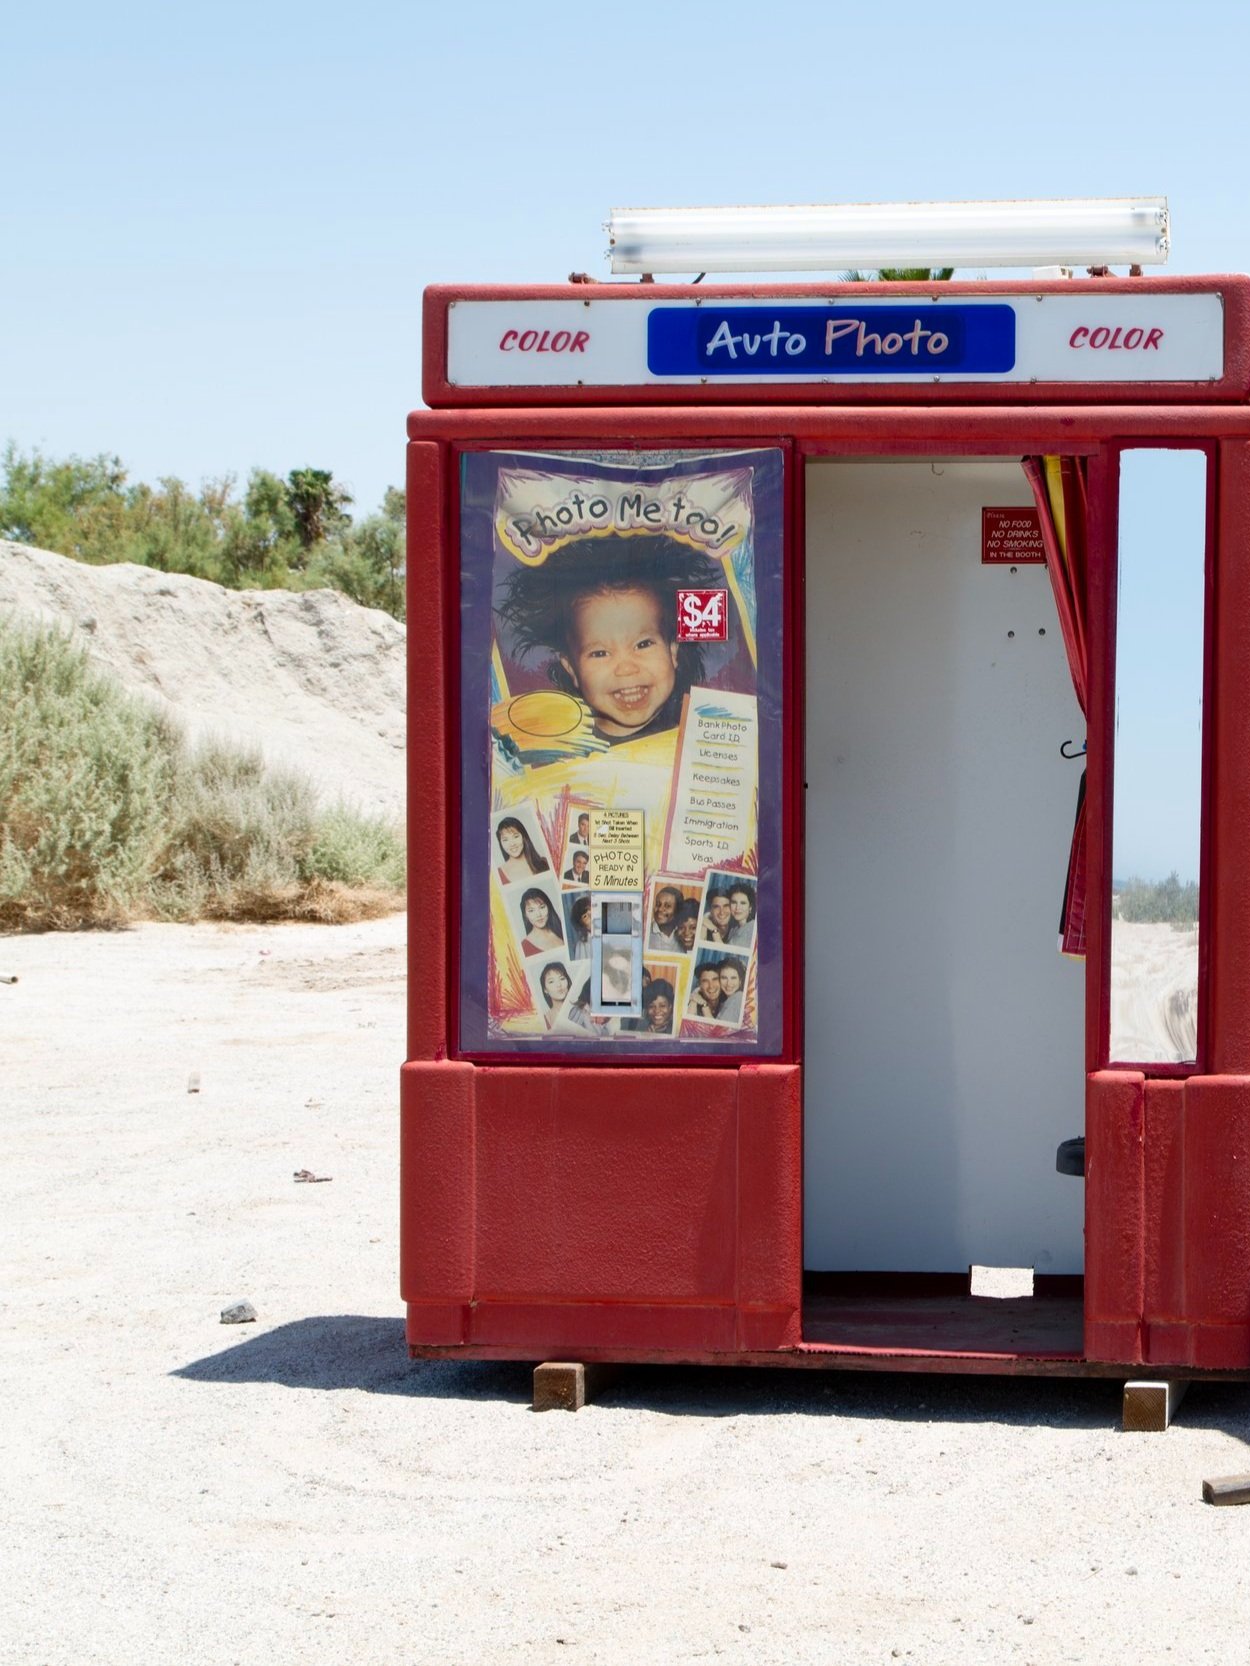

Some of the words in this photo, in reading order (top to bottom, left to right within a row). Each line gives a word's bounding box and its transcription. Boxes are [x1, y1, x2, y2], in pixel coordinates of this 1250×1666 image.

[499, 329, 591, 353] COLOR
[706, 320, 807, 360] Auto
[823, 319, 950, 357] Photo
[1069, 326, 1165, 350] COLOR
[512, 494, 609, 546] Photo
[619, 493, 662, 524] Me
[673, 496, 737, 543] too!
[999, 520, 1011, 529] NO
[1012, 520, 1032, 529] FOOD
[991, 530, 1006, 538] NO
[1007, 530, 1040, 538] DRINKS
[986, 540, 1001, 548] NO
[1002, 540, 1044, 548] SMOKING
[683, 593, 722, 630] $4
[698, 719, 720, 730] Bank
[721, 721, 748, 732] Photo
[703, 731, 726, 741] Card
[699, 748, 739, 762] Licenses
[692, 772, 741, 787] Keepsakes
[690, 796, 705, 807] Bus
[706, 798, 737, 811] Passes
[683, 815, 739, 832] Immigration
[684, 836, 714, 848] Sports
[593, 850, 640, 864] PHOTOS
[691, 852, 714, 864] Visas
[594, 874, 602, 887] 5
[603, 874, 640, 887] Minutes
